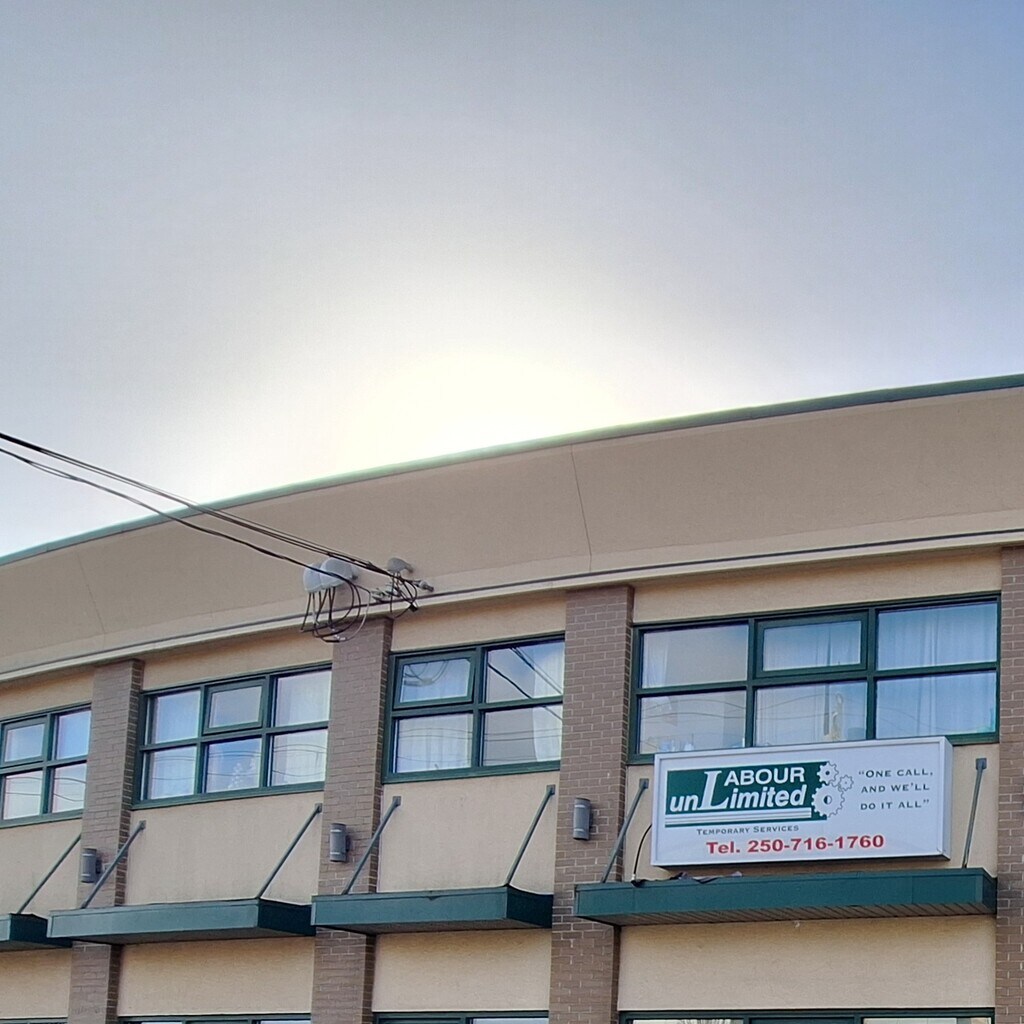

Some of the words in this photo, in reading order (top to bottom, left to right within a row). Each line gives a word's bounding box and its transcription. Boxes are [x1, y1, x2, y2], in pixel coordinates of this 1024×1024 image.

[701, 766, 806, 811] LABOUR
[860, 785, 887, 794] AND
[860, 802, 877, 811] DO
[881, 802, 893, 810] IT
[706, 841, 741, 855] Tel.
[747, 834, 885, 853] 250-716-1760
